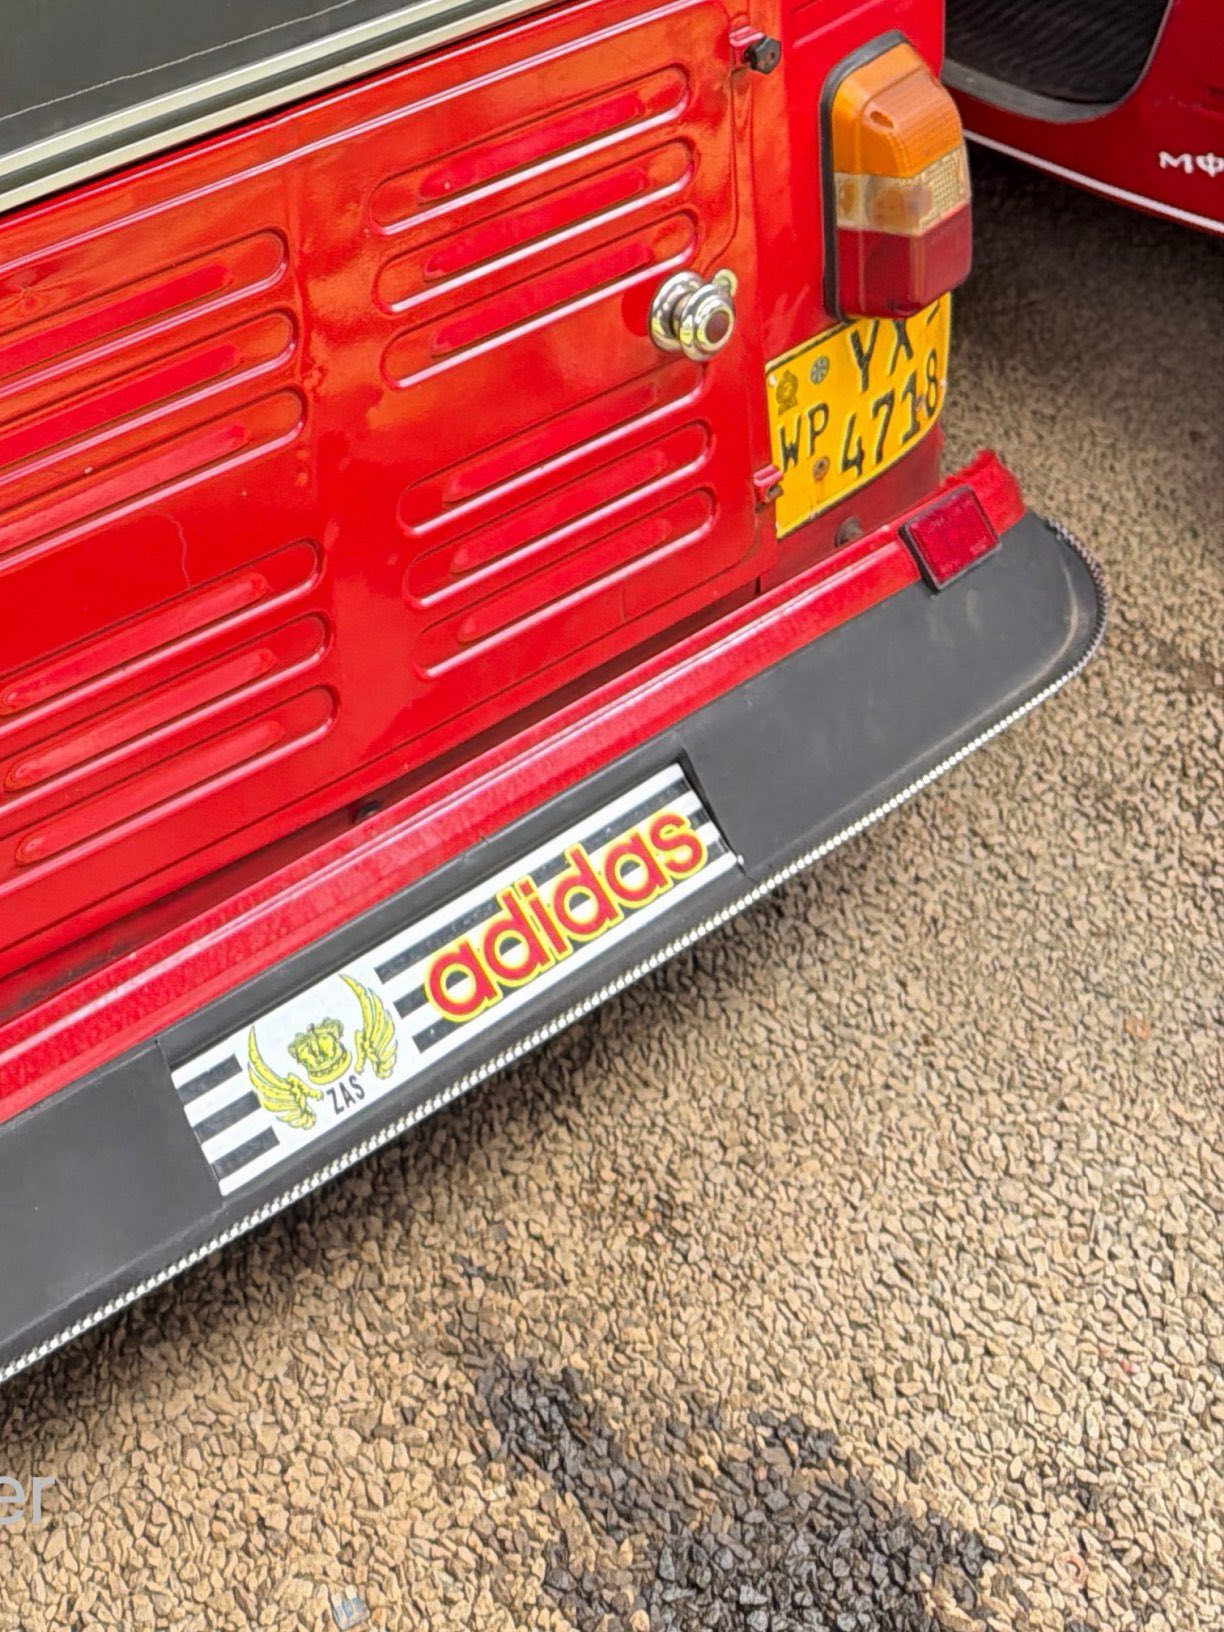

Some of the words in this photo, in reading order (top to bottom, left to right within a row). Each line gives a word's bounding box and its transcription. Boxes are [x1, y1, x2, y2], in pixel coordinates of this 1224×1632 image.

[779, 401, 829, 473] WP
[841, 347, 939, 477] 4718
[424, 810, 708, 1023] adidas
[326, 1074, 366, 1116] ZAS
